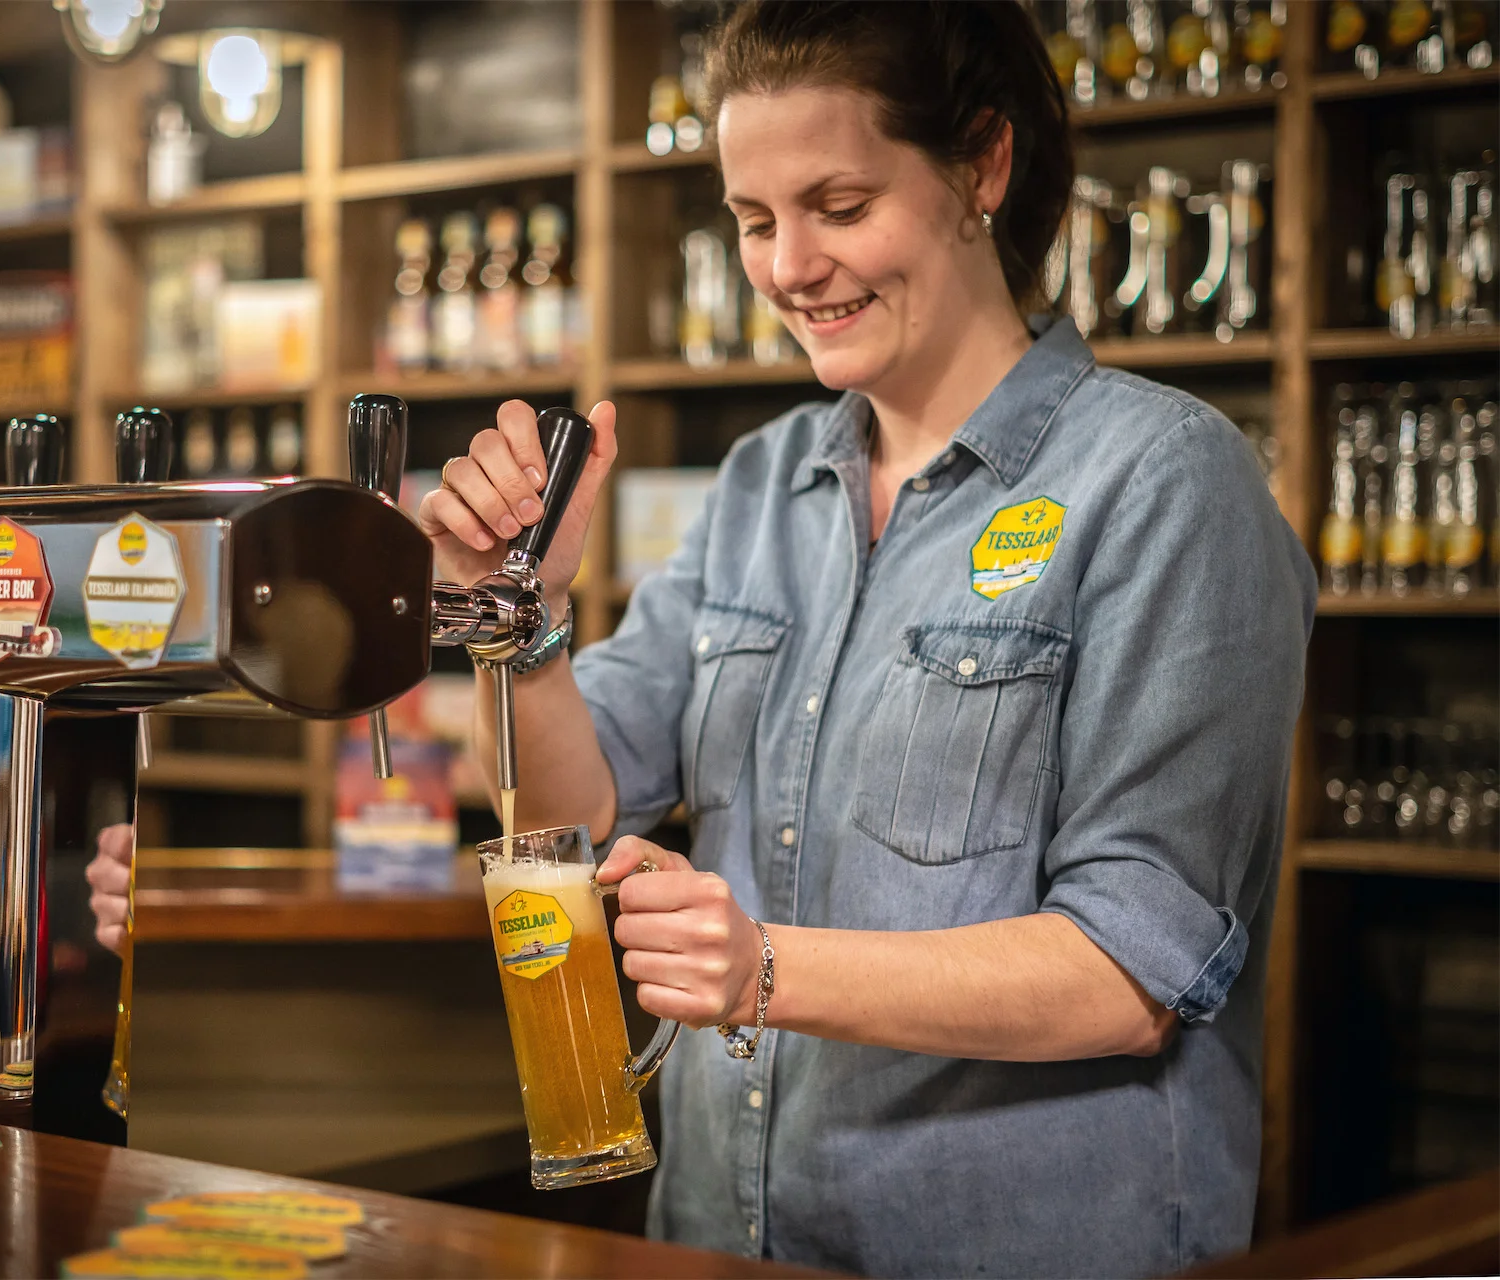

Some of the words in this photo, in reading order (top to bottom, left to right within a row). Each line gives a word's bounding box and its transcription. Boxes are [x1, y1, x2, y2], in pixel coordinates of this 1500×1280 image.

[988, 525, 1059, 550] TESSELAAR
[12, 580, 36, 599] BOK
[88, 580, 131, 597] TESSELAAR
[499, 912, 556, 934] TESSELAAR
